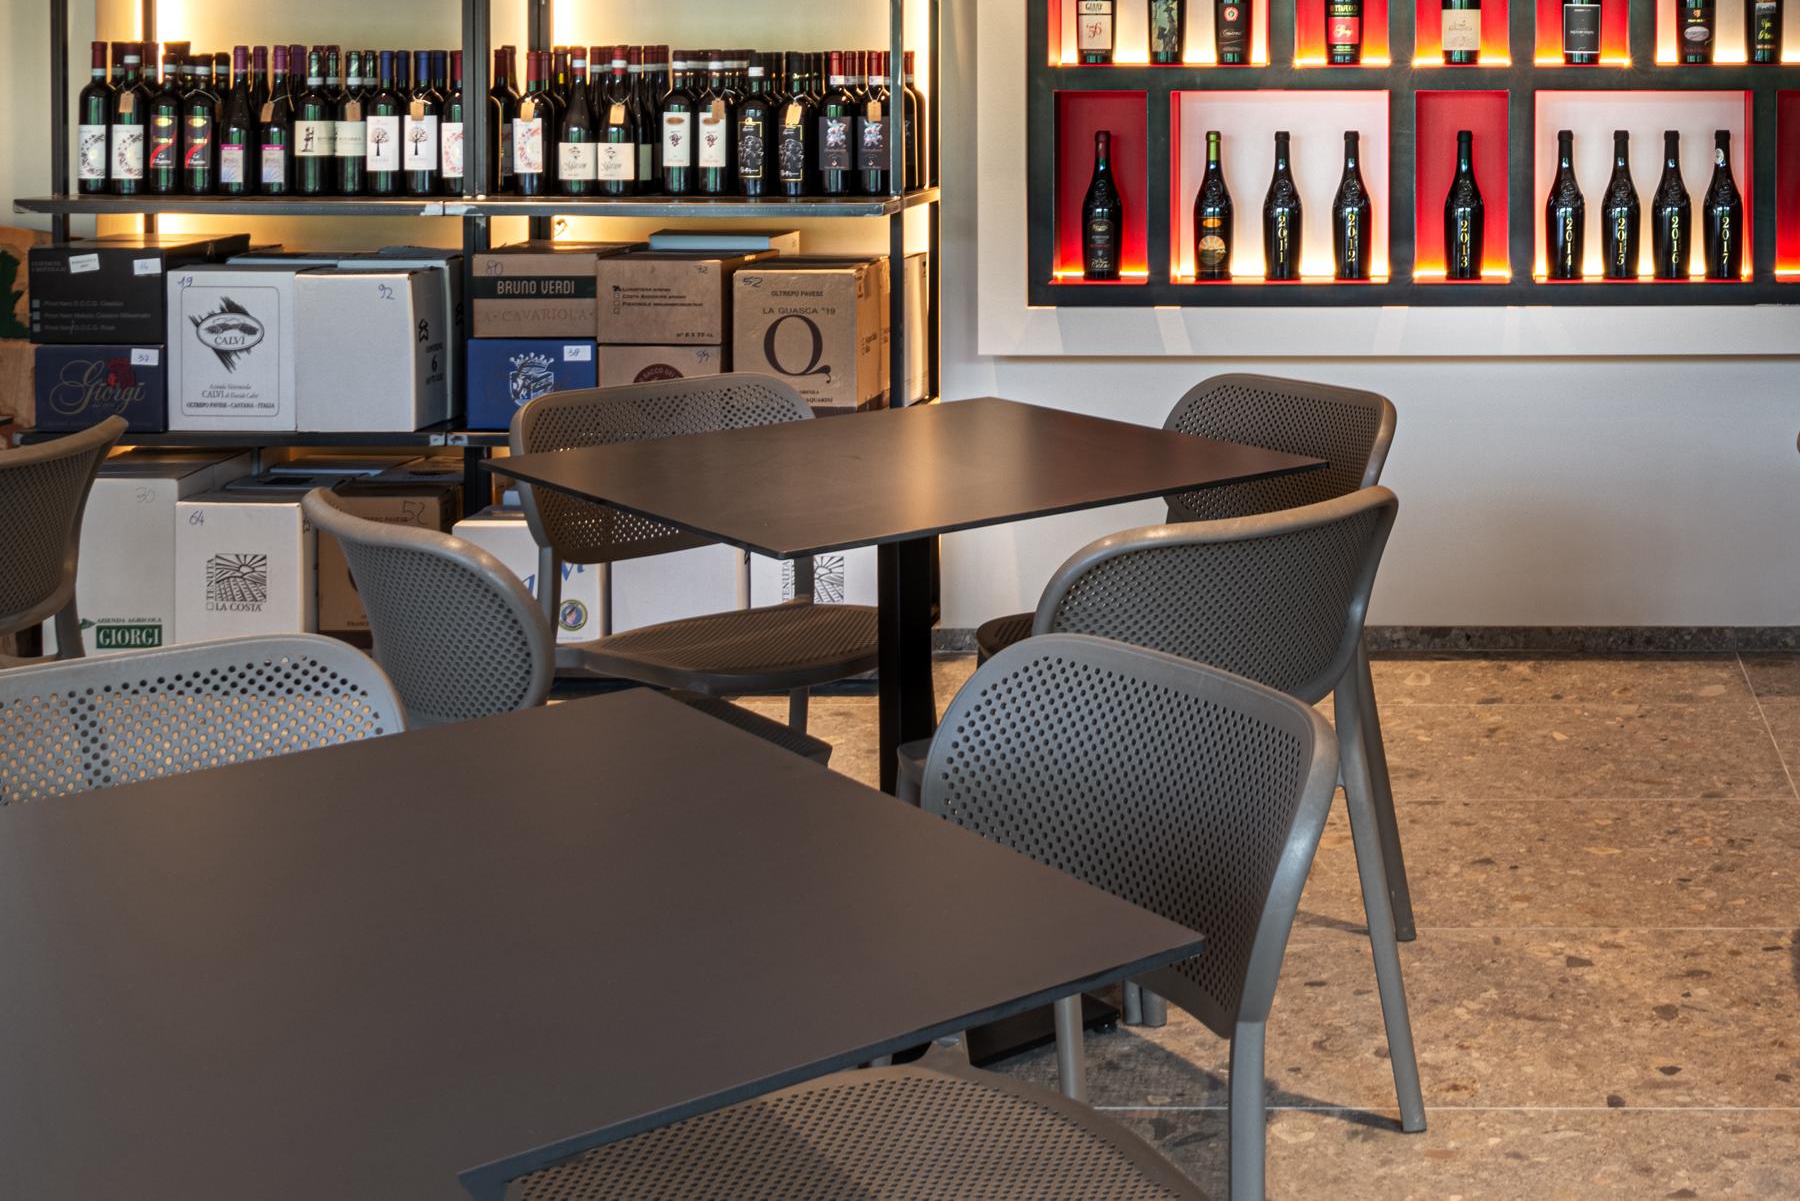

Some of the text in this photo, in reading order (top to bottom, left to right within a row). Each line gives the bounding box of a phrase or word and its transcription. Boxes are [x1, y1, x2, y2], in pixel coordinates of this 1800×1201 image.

[1278, 215, 1287, 264] 2011
[1347, 214, 1357, 263] 2012
[1460, 219, 1470, 268] 2013
[1564, 217, 1574, 267] 2014
[1617, 217, 1626, 267] 2015
[1671, 216, 1680, 265] 2016
[1721, 216, 1731, 265] 2017
[378, 284, 395, 299] 92
[497, 280, 575, 294] BRUNO VERDI
[742, 276, 764, 287] 52
[778, 307, 818, 315] GUASCA
[214, 336, 246, 345] CALVI
[763, 314, 832, 384] Q
[50, 359, 147, 414] Giorgi
[188, 510, 205, 526] 64
[402, 500, 430, 526] 52
[206, 558, 215, 601] TENUTA
[215, 602, 263, 612] LA COSTA
[99, 627, 161, 646] GIORGI
